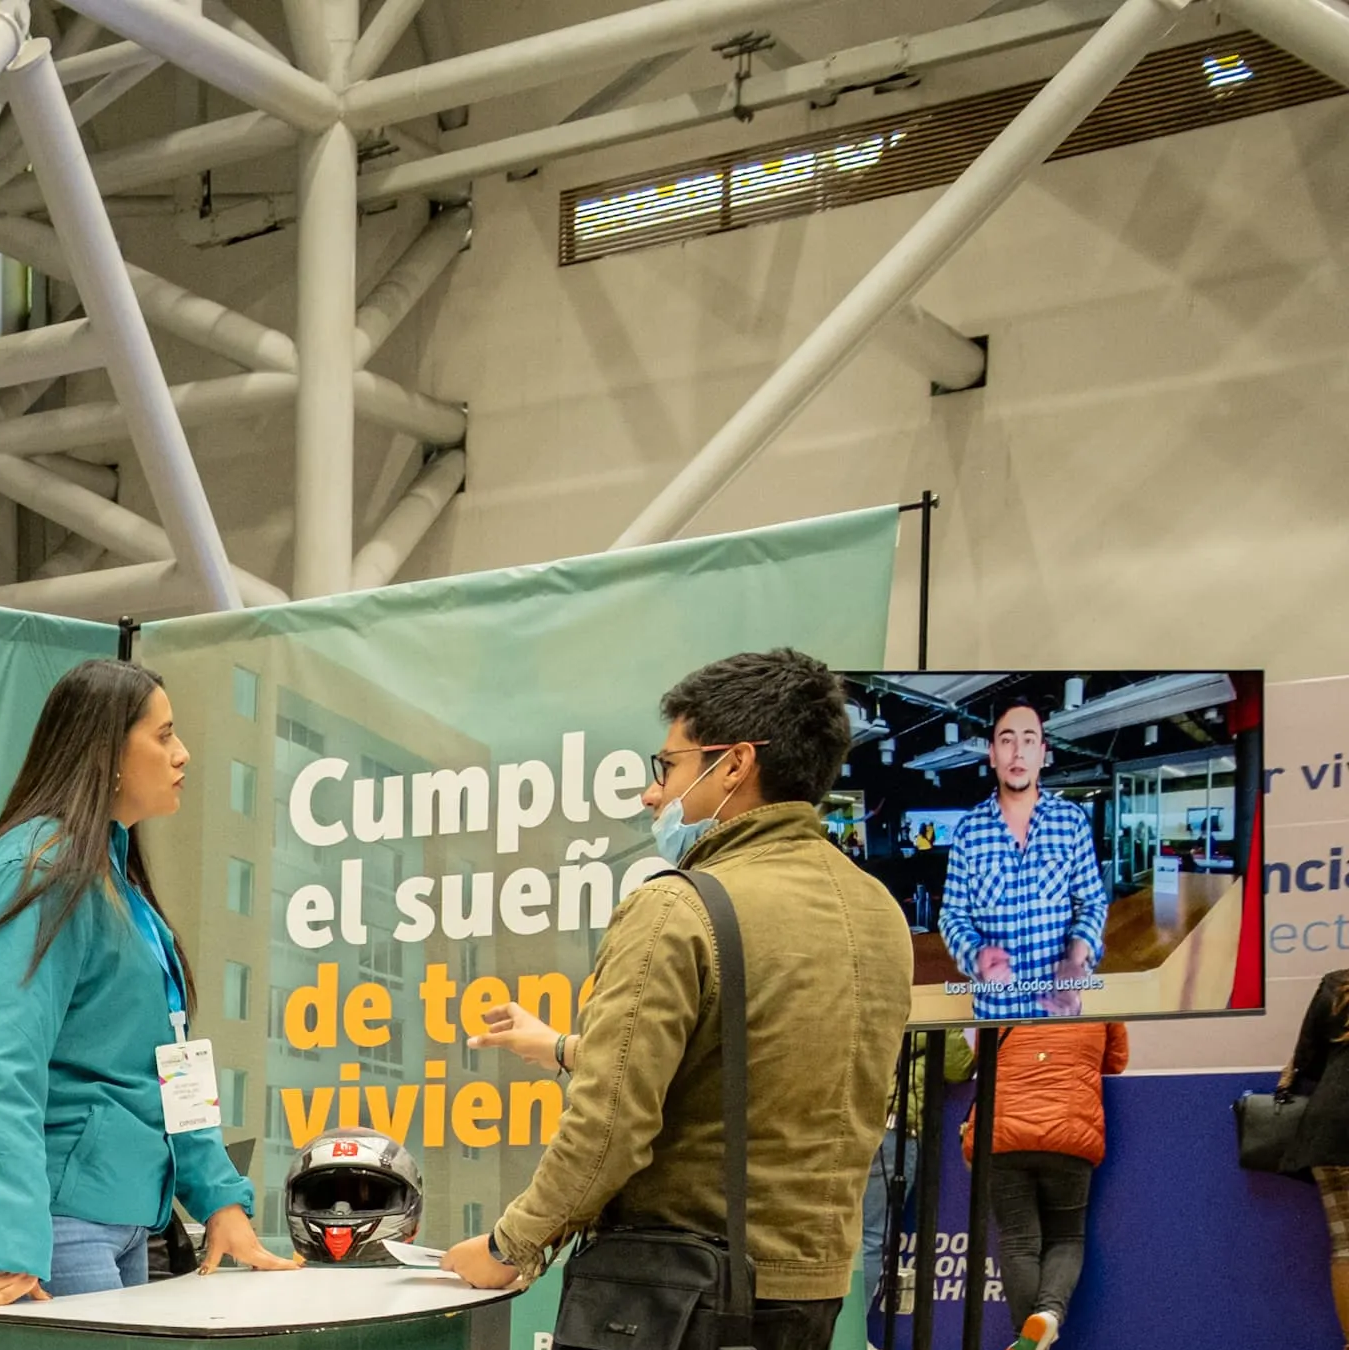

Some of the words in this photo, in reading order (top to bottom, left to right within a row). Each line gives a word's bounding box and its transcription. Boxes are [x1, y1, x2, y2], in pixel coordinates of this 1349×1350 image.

[289, 730, 647, 854] Cumple
[1301, 753, 1349, 790] vi
[285, 858, 367, 949] el
[1263, 847, 1349, 895] nci
[283, 962, 392, 1050] de
[419, 962, 596, 1044] ten
[944, 980, 967, 994] Los
[969, 979, 1005, 993] invito
[1007, 982, 1015, 992] a
[1017, 979, 1053, 992] todos
[1056, 977, 1104, 990] ustedes
